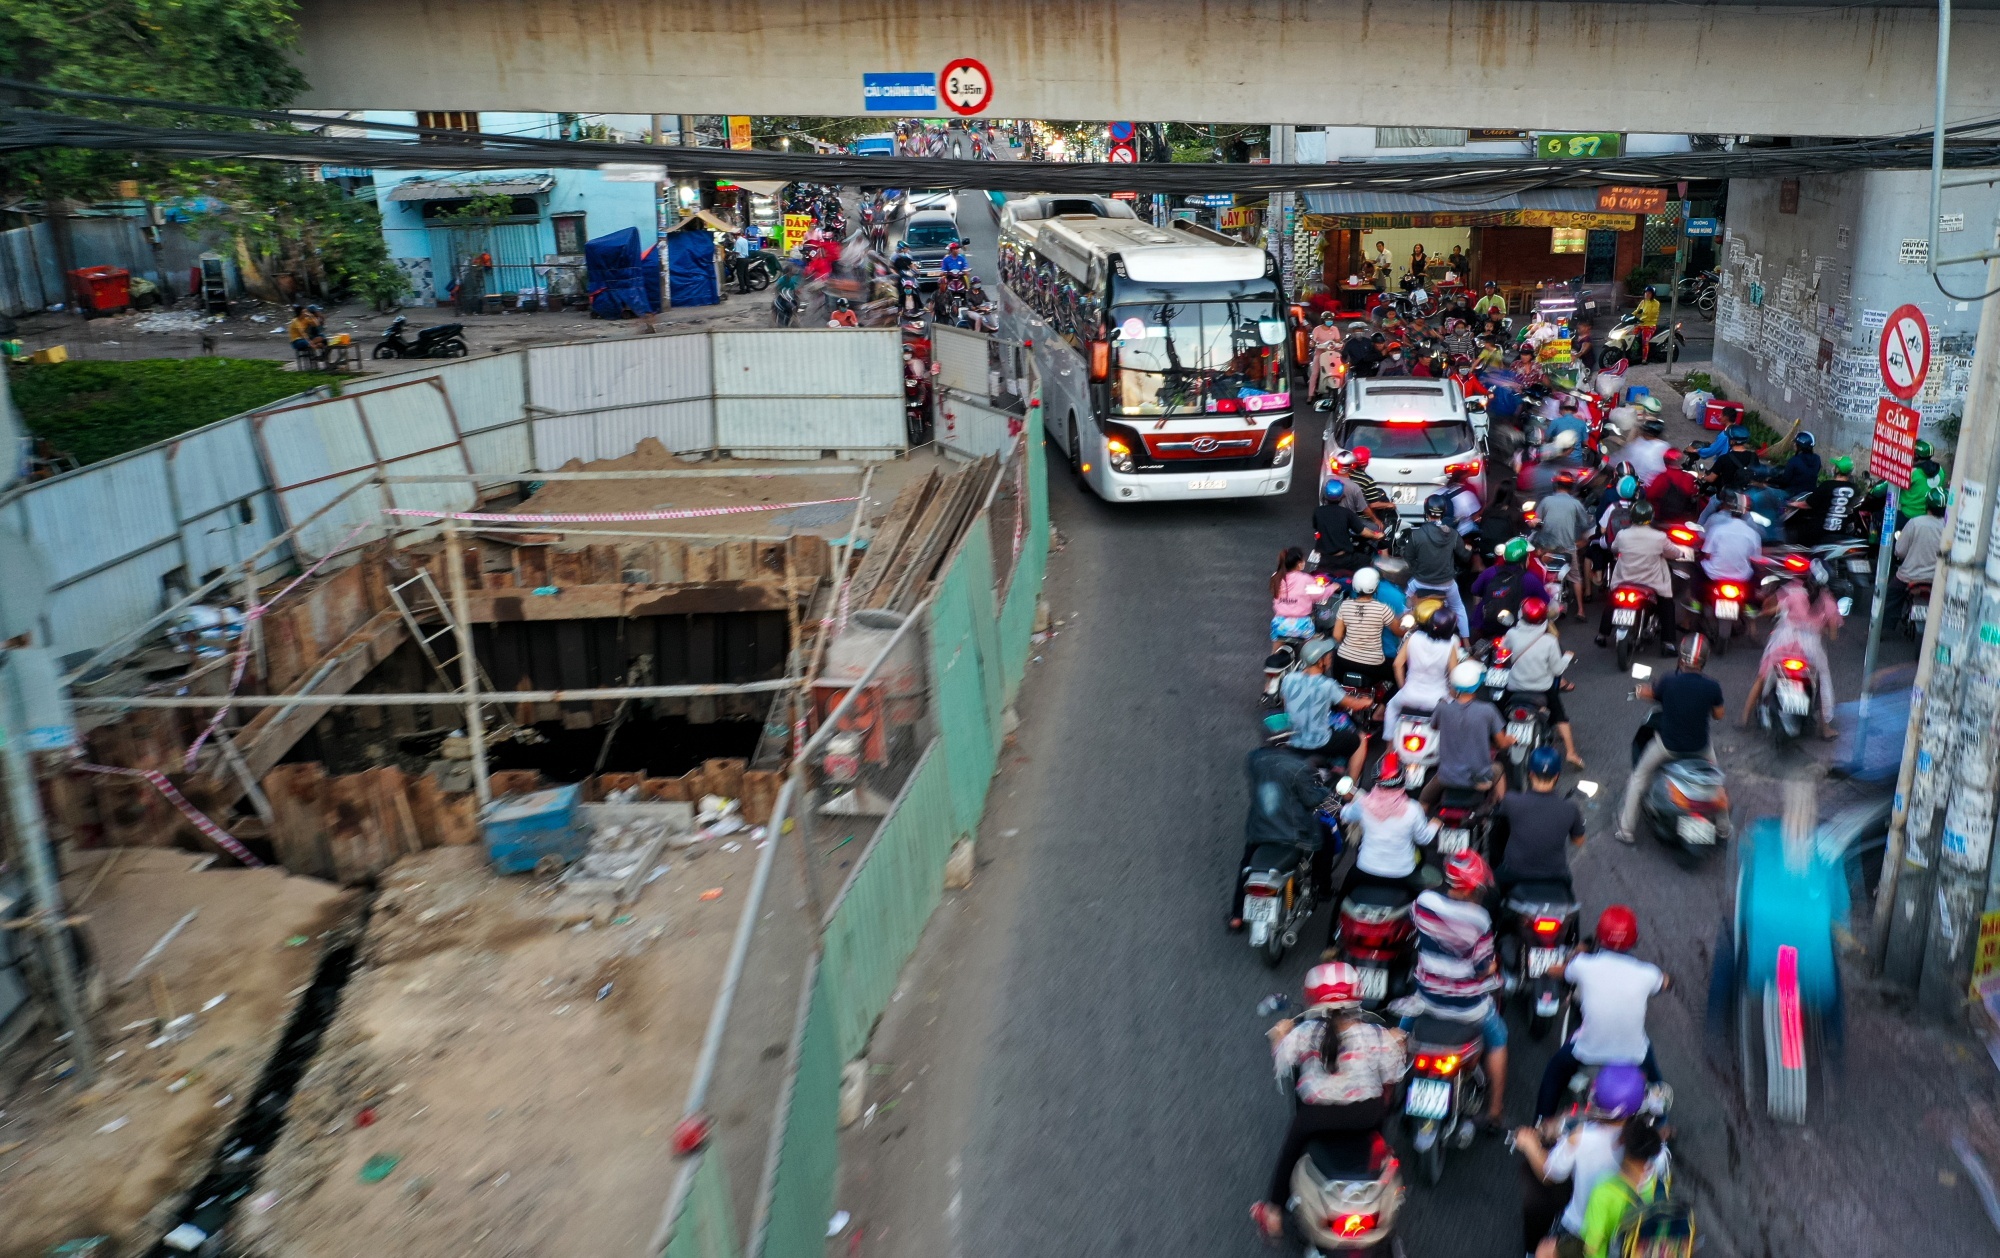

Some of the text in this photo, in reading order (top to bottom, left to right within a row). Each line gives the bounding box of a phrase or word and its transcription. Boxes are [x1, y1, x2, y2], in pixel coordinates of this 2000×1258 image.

[1569, 136, 1600, 156] 87
[1571, 212, 1597, 221] Cafe
[1886, 407, 1910, 431] CẤM
